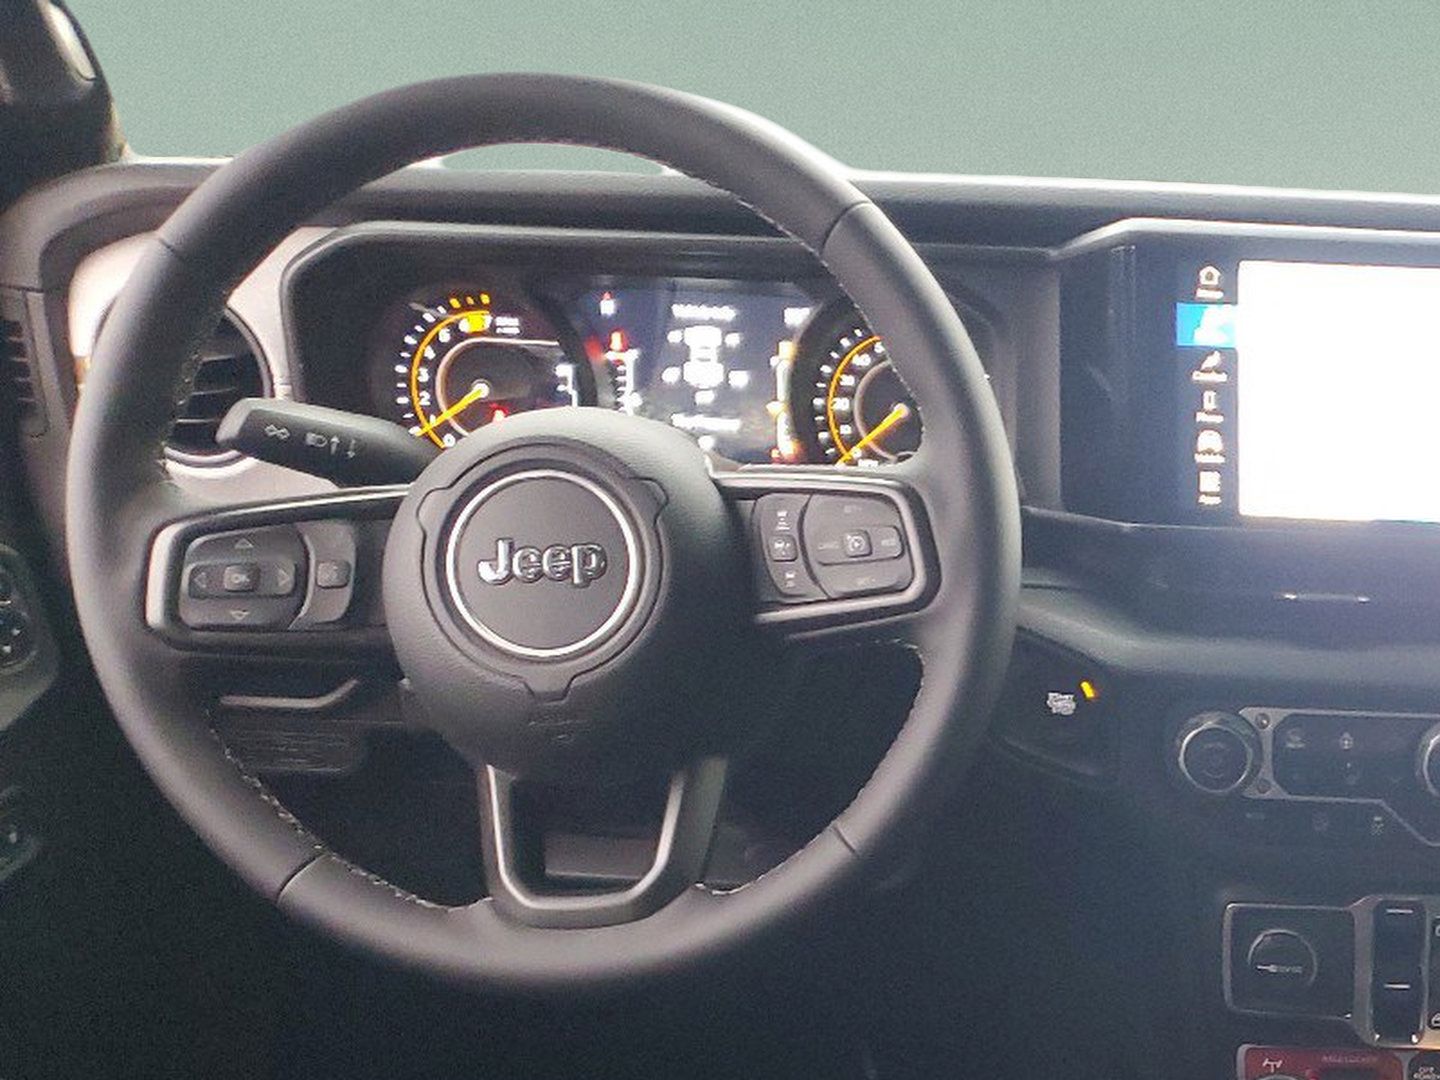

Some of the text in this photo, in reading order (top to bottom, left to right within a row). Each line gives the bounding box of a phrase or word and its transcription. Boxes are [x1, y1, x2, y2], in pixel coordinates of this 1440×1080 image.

[417, 367, 429, 382] 3
[418, 390, 431, 405] 2
[443, 433, 455, 447] 0
[477, 537, 608, 588] Jeep
